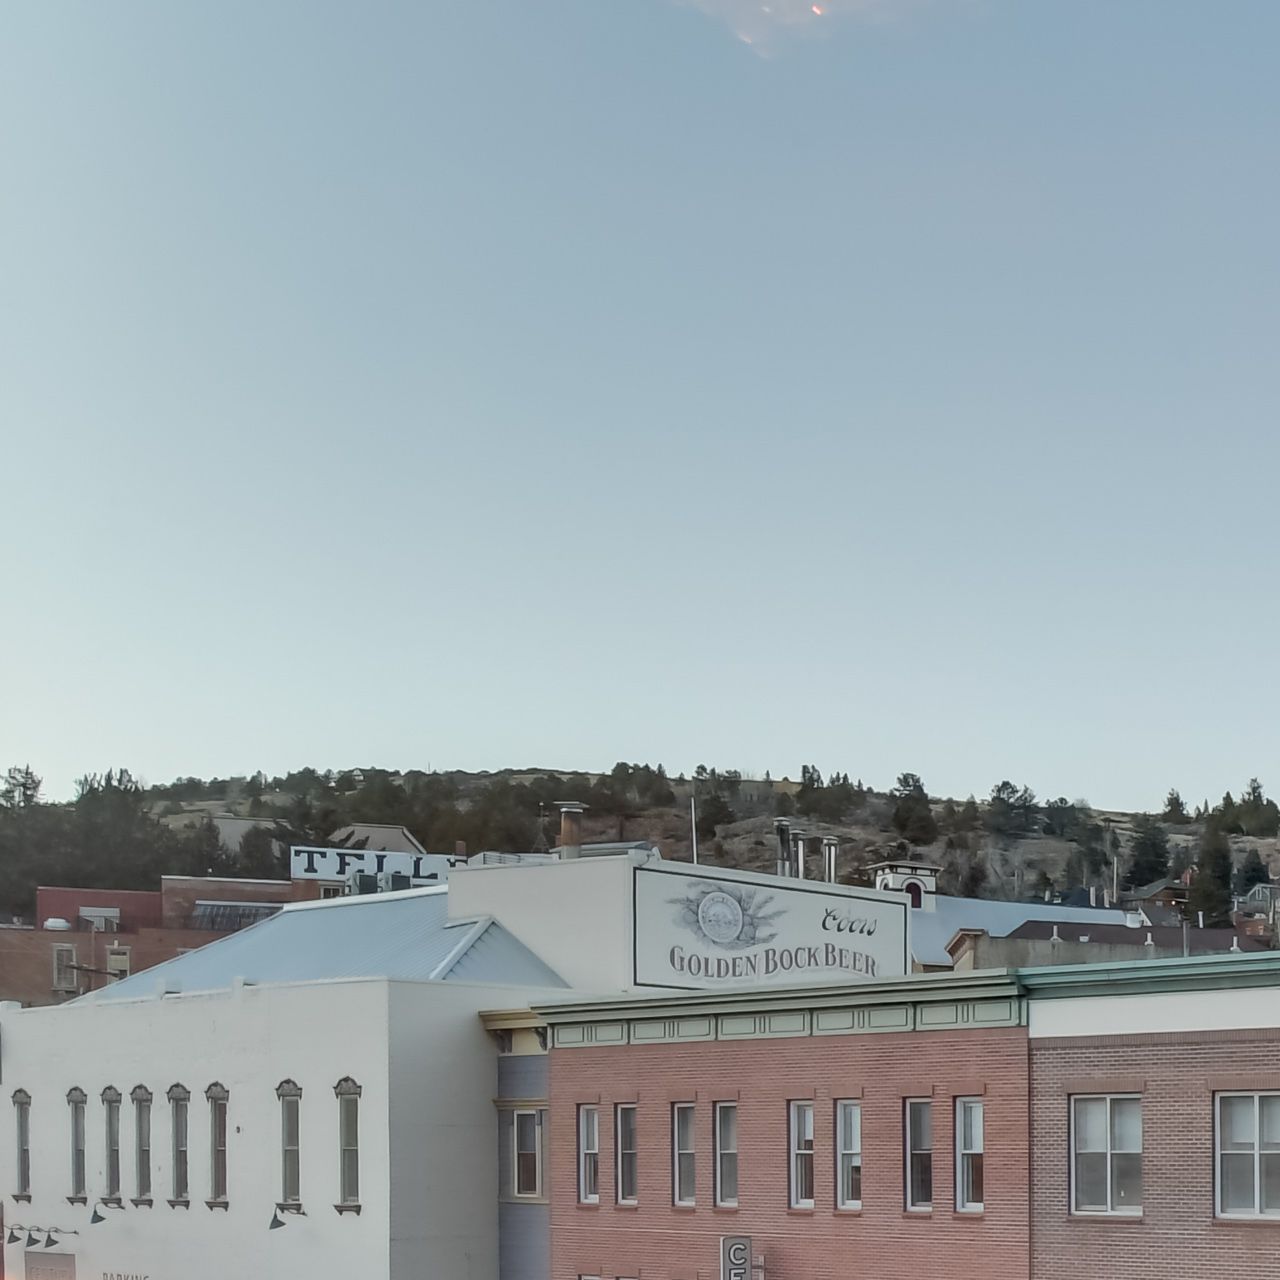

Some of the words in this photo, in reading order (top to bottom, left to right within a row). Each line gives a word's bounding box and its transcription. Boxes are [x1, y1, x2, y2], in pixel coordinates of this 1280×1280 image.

[821, 908, 877, 936] Coors
[669, 945, 757, 978] GOLDEN
[764, 947, 819, 975] BOCK
[824, 943, 877, 977] BEER
